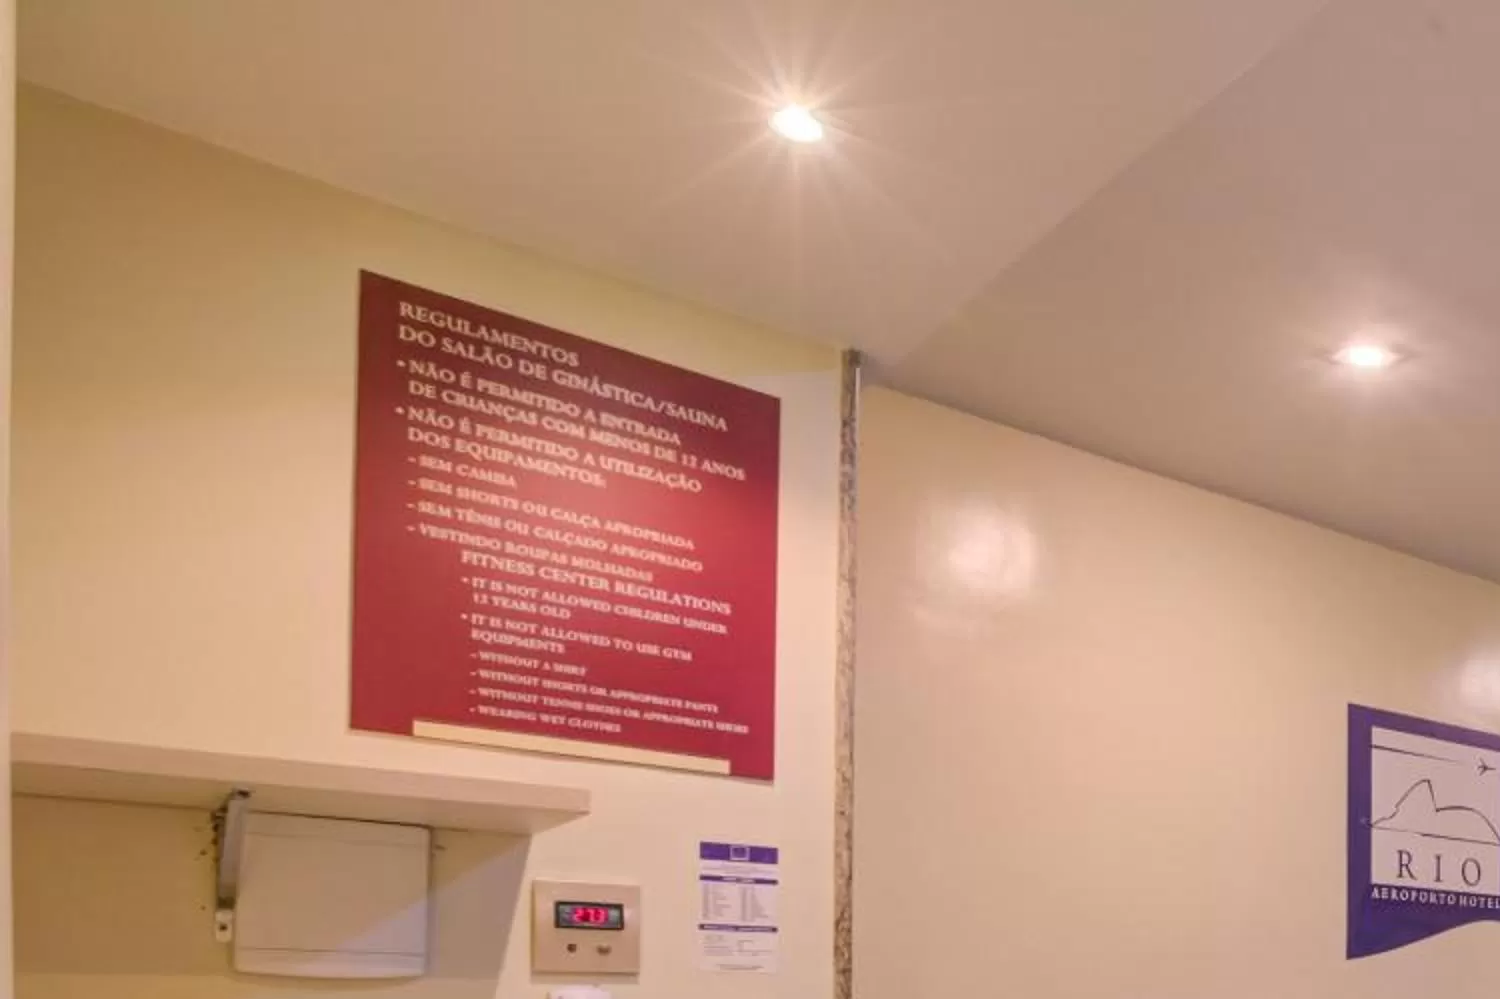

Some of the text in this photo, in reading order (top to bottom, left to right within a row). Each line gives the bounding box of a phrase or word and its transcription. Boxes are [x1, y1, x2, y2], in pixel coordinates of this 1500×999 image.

[399, 324, 436, 348] DO
[441, 336, 513, 369] SALÃO
[518, 359, 547, 381] DE
[400, 301, 579, 367] REGULAMENTOS
[409, 359, 456, 383] NÃO
[477, 378, 581, 416] PERMITIDO
[584, 408, 596, 423] A
[600, 411, 681, 445] ENTRADA
[408, 380, 437, 399] DE
[441, 389, 538, 425] CRIANÇAS
[541, 416, 585, 440] COM
[589, 427, 651, 455] MENOS
[654, 444, 678, 462] DE
[702, 459, 746, 481] ANOS
[408, 426, 450, 448] DOS
[408, 405, 454, 429] NÃO
[476, 423, 578, 461] PERMITIDO
[584, 451, 596, 466] A
[599, 455, 702, 493] UTILIZAÇÃO
[418, 500, 451, 517] SEM
[504, 519, 528, 535] OU
[611, 543, 703, 573] APROPRIADO
[522, 500, 547, 517] OU
[550, 508, 600, 528] CALÇA
[604, 519, 695, 550] APROPRIADA
[504, 541, 568, 564] ROUPAS
[461, 550, 732, 616] FITNESS CENTER REGULATIONS
[472, 577, 487, 589] IT
[505, 583, 539, 599] NOT
[542, 591, 611, 613] ALLOWED
[471, 613, 486, 625] IT
[505, 619, 539, 634] NOT
[541, 626, 611, 647] ALLOWED
[612, 637, 633, 652] TO
[540, 604, 571, 620] OLD
[1396, 850, 1481, 887] RIO
